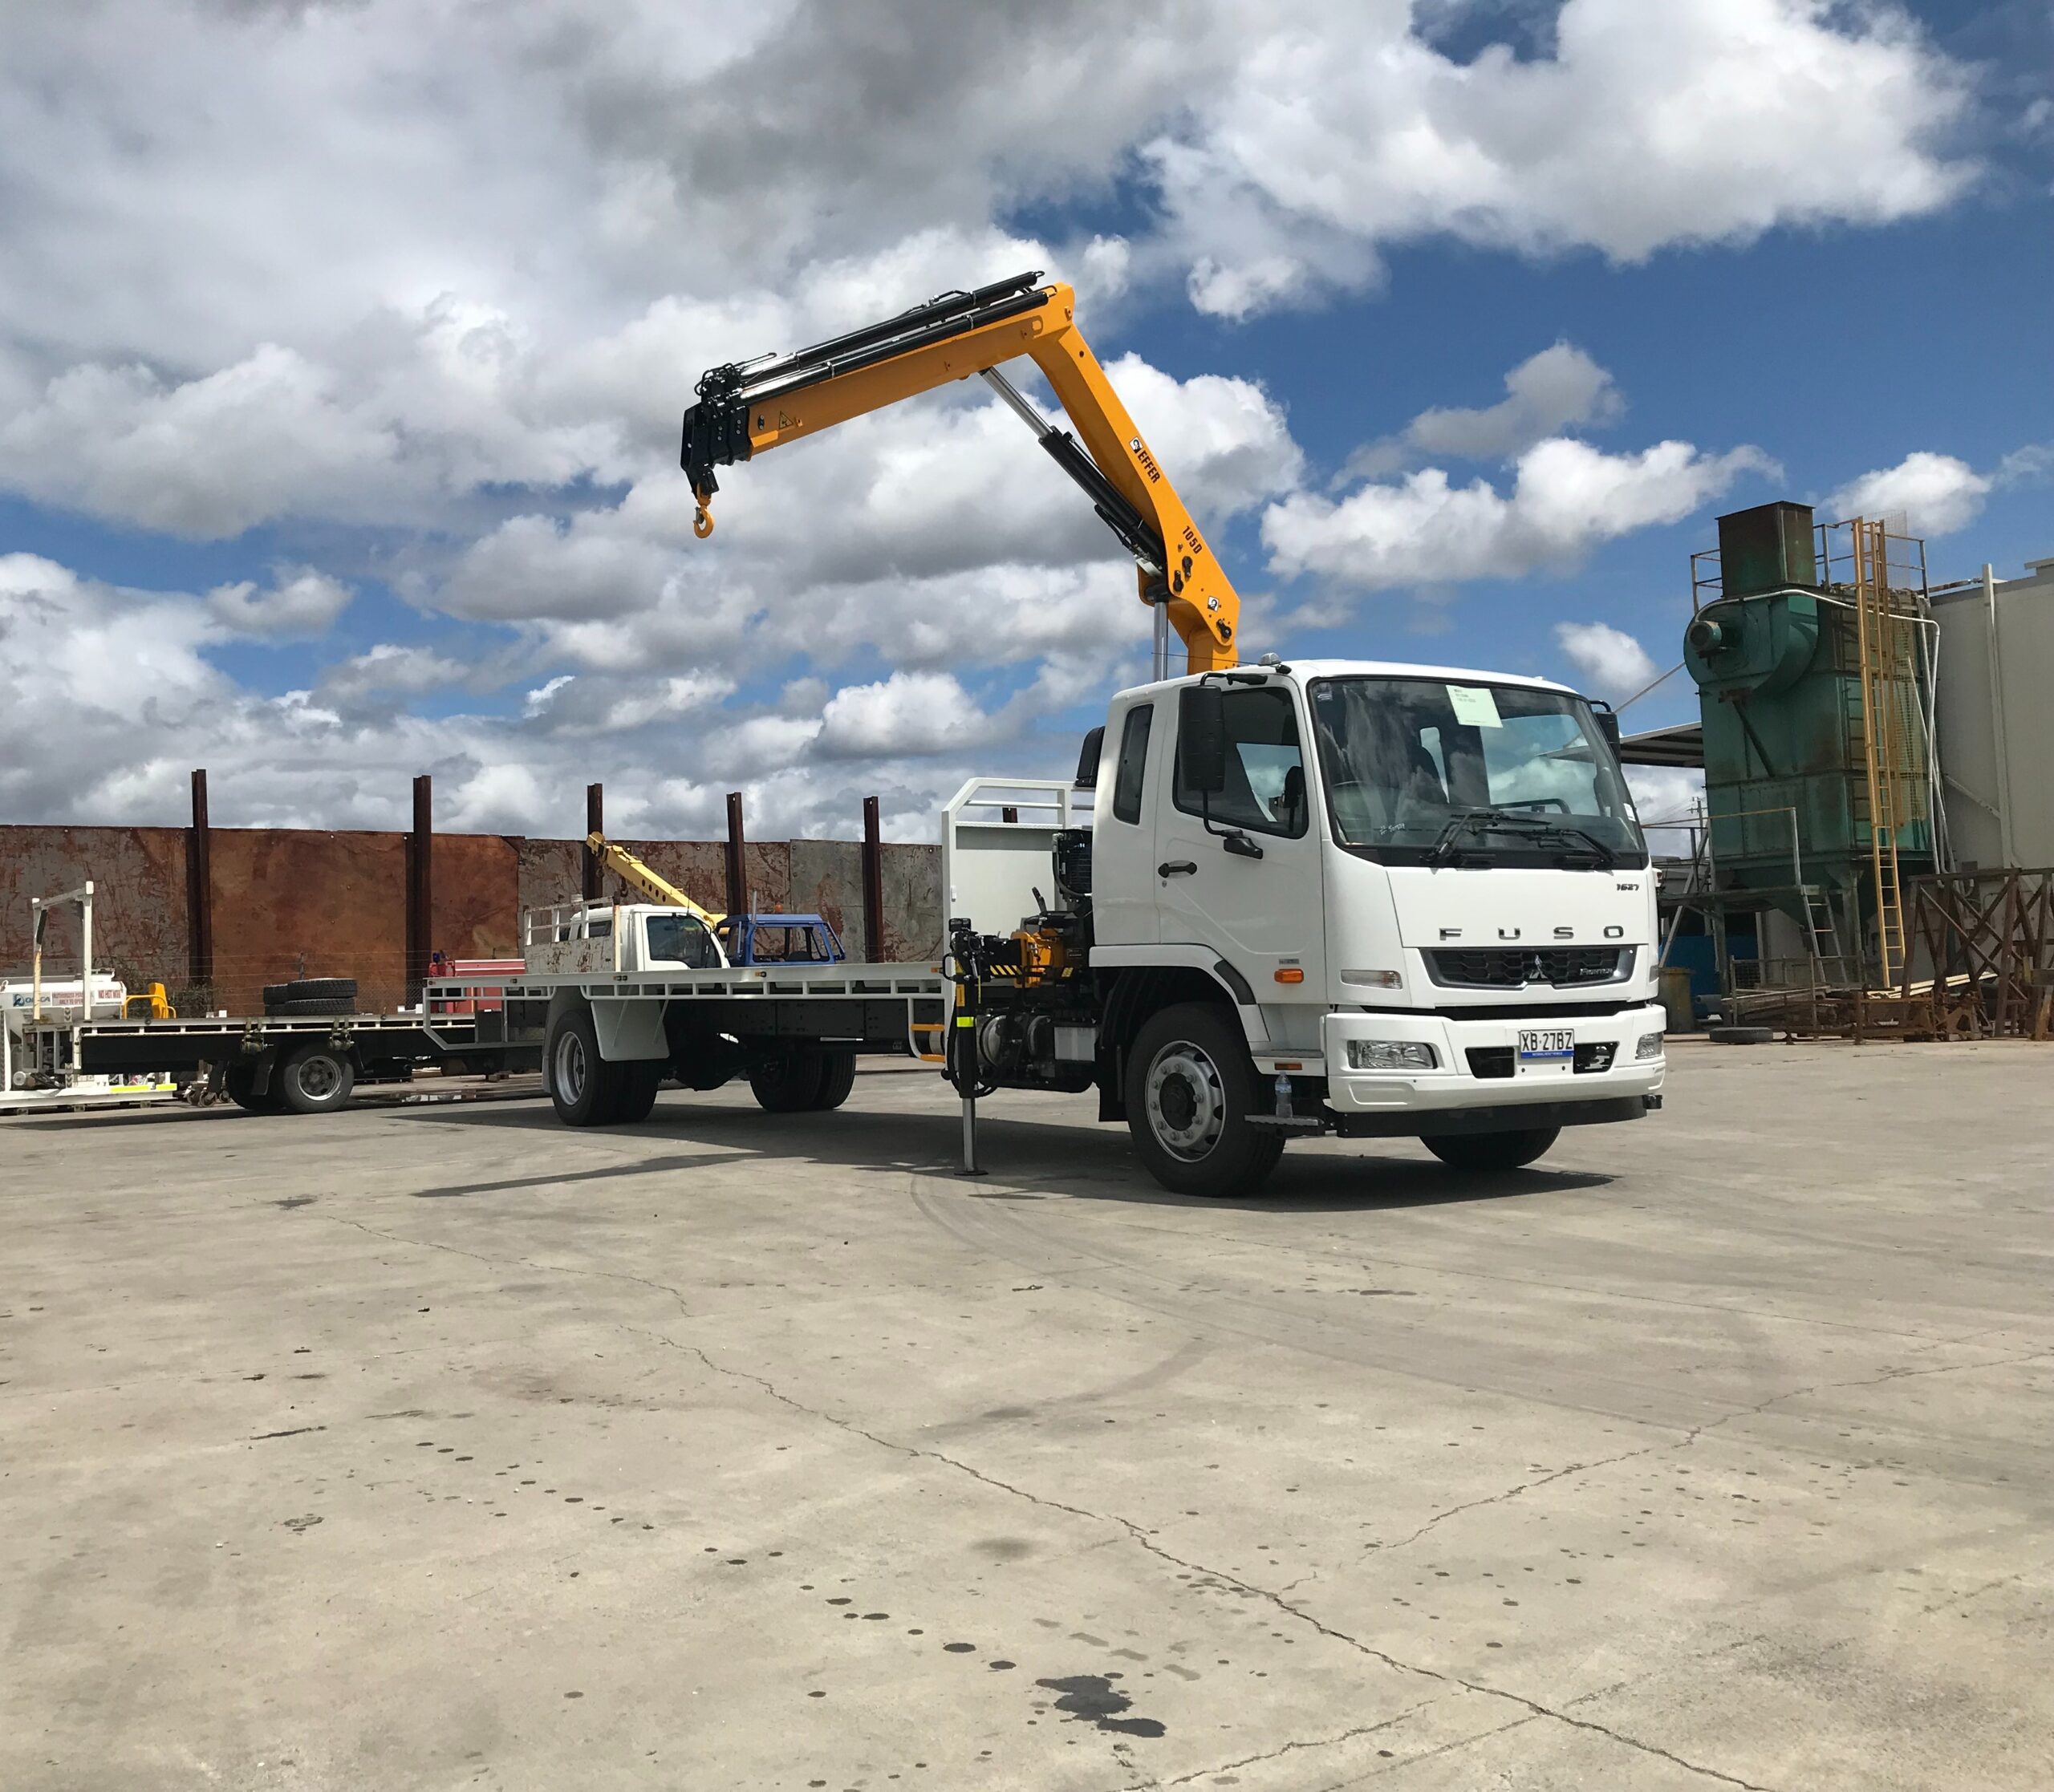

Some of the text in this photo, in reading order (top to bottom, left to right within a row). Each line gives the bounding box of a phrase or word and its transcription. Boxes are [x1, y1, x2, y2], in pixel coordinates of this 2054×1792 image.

[1138, 450, 1160, 484] EFFER
[1616, 883, 1640, 891] 1627
[1439, 925, 1625, 941] FUSO
